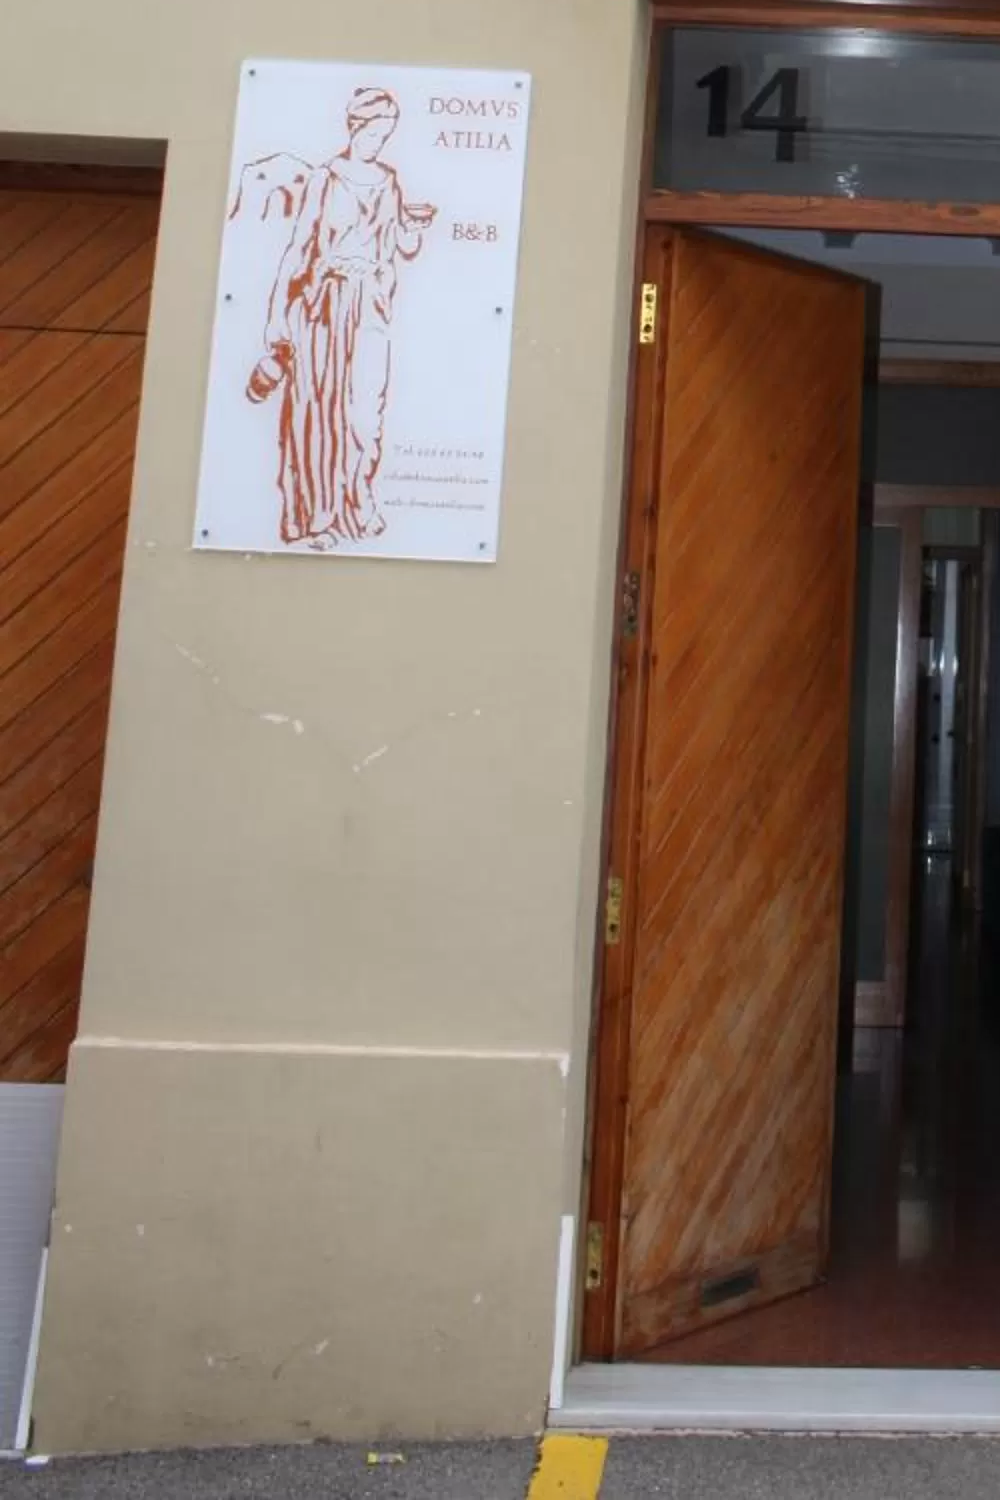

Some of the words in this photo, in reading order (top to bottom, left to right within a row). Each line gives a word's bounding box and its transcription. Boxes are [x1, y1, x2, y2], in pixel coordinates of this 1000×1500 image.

[429, 97, 518, 118] DOMVS
[696, 65, 807, 163] 14
[432, 131, 512, 150] ATILIA
[452, 223, 498, 241] B&B
